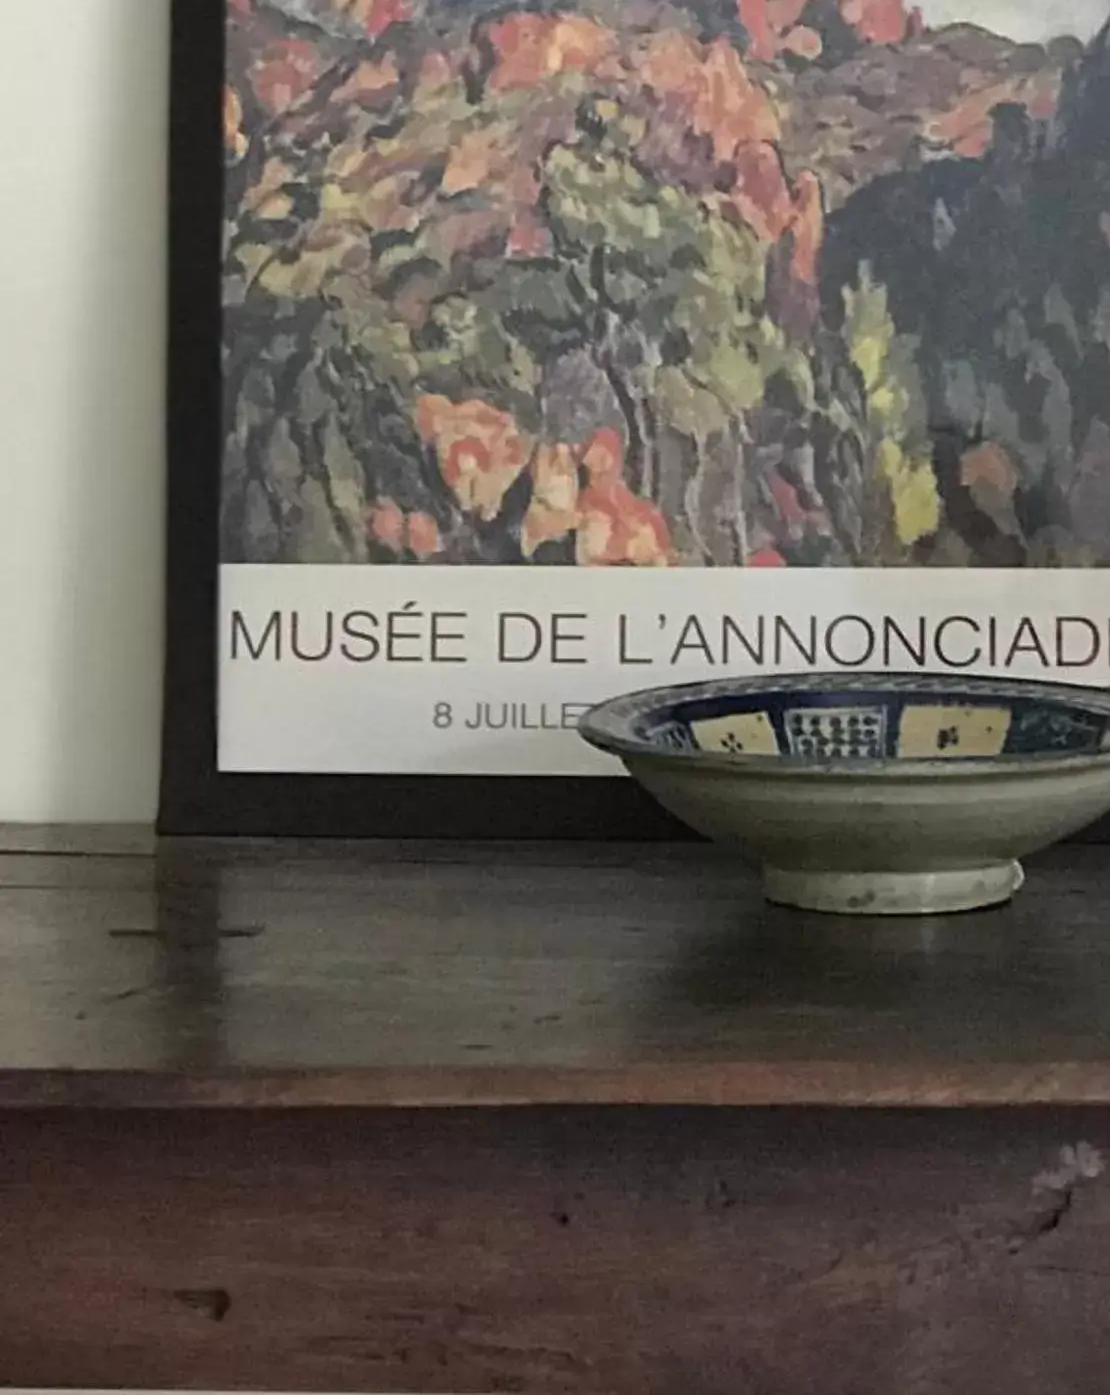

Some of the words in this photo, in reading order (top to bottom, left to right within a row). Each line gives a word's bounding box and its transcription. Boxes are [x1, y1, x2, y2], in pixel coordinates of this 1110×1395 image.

[229, 599, 469, 664] MUSÉE
[496, 610, 589, 665] DE
[432, 701, 453, 730] 8
[464, 701, 597, 731] JUILLE
